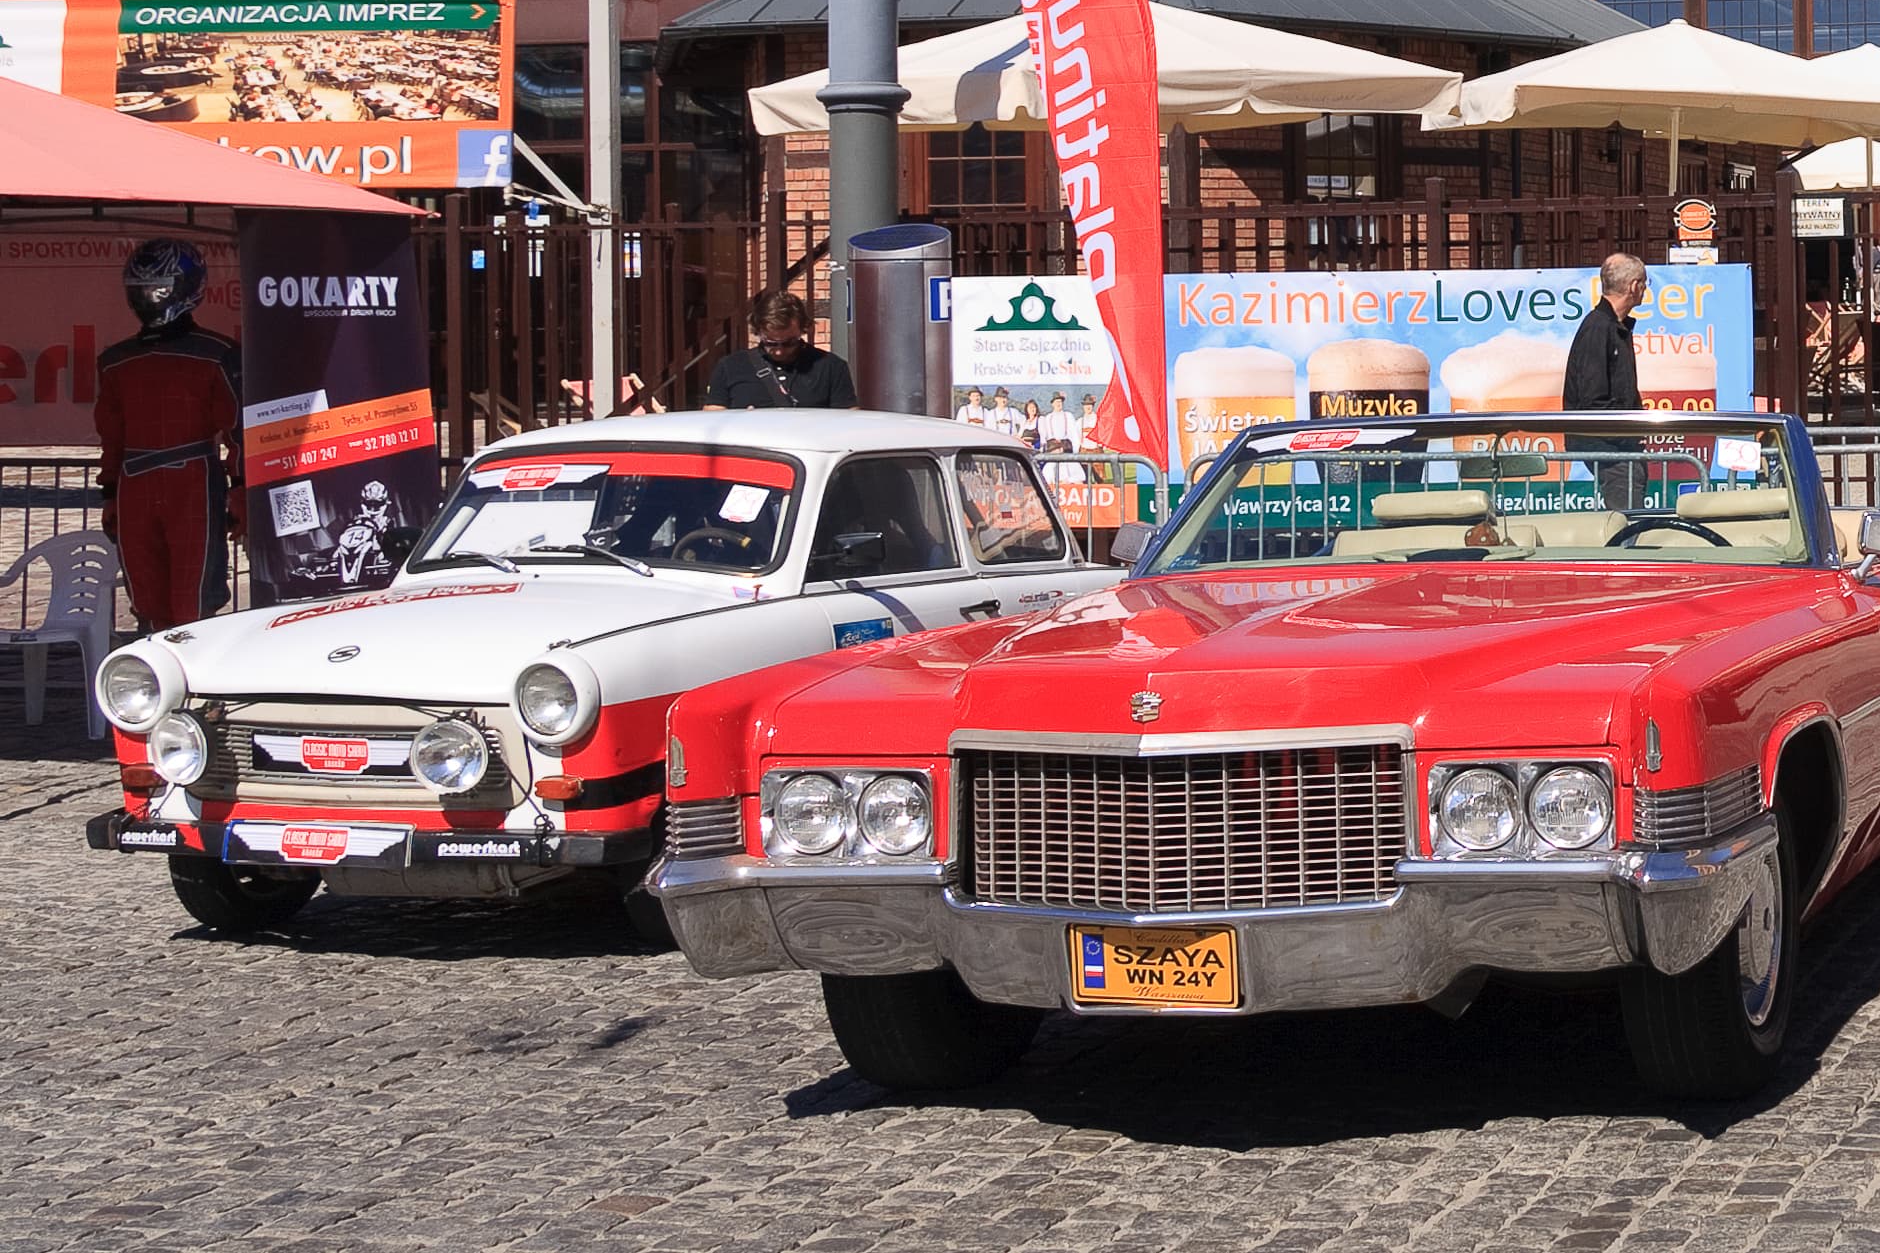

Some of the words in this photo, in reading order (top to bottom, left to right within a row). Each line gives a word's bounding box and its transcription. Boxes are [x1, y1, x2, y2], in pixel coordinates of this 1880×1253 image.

[135, 5, 332, 26] ORGANIZACJA
[338, 2, 446, 23] IMPREZ
[9, 239, 111, 259] SPORTÓW
[258, 276, 399, 307] GOKARTY
[974, 337, 1014, 352] Stara
[1019, 337, 1091, 355] Zajezdnia
[974, 362, 1024, 377] Kraków
[1039, 359, 1092, 376] DeSilva
[364, 436, 378, 451] 32
[399, 431, 409, 443] 12
[282, 455, 298, 470] 511
[300, 449, 317, 466] 407
[320, 445, 338, 462] 247
[1329, 496, 1351, 512] 12
[438, 840, 520, 857] powerkart
[1113, 945, 1225, 969] SZAYA
[1126, 969, 1164, 985] WN
[1172, 969, 1217, 987] 24Y
